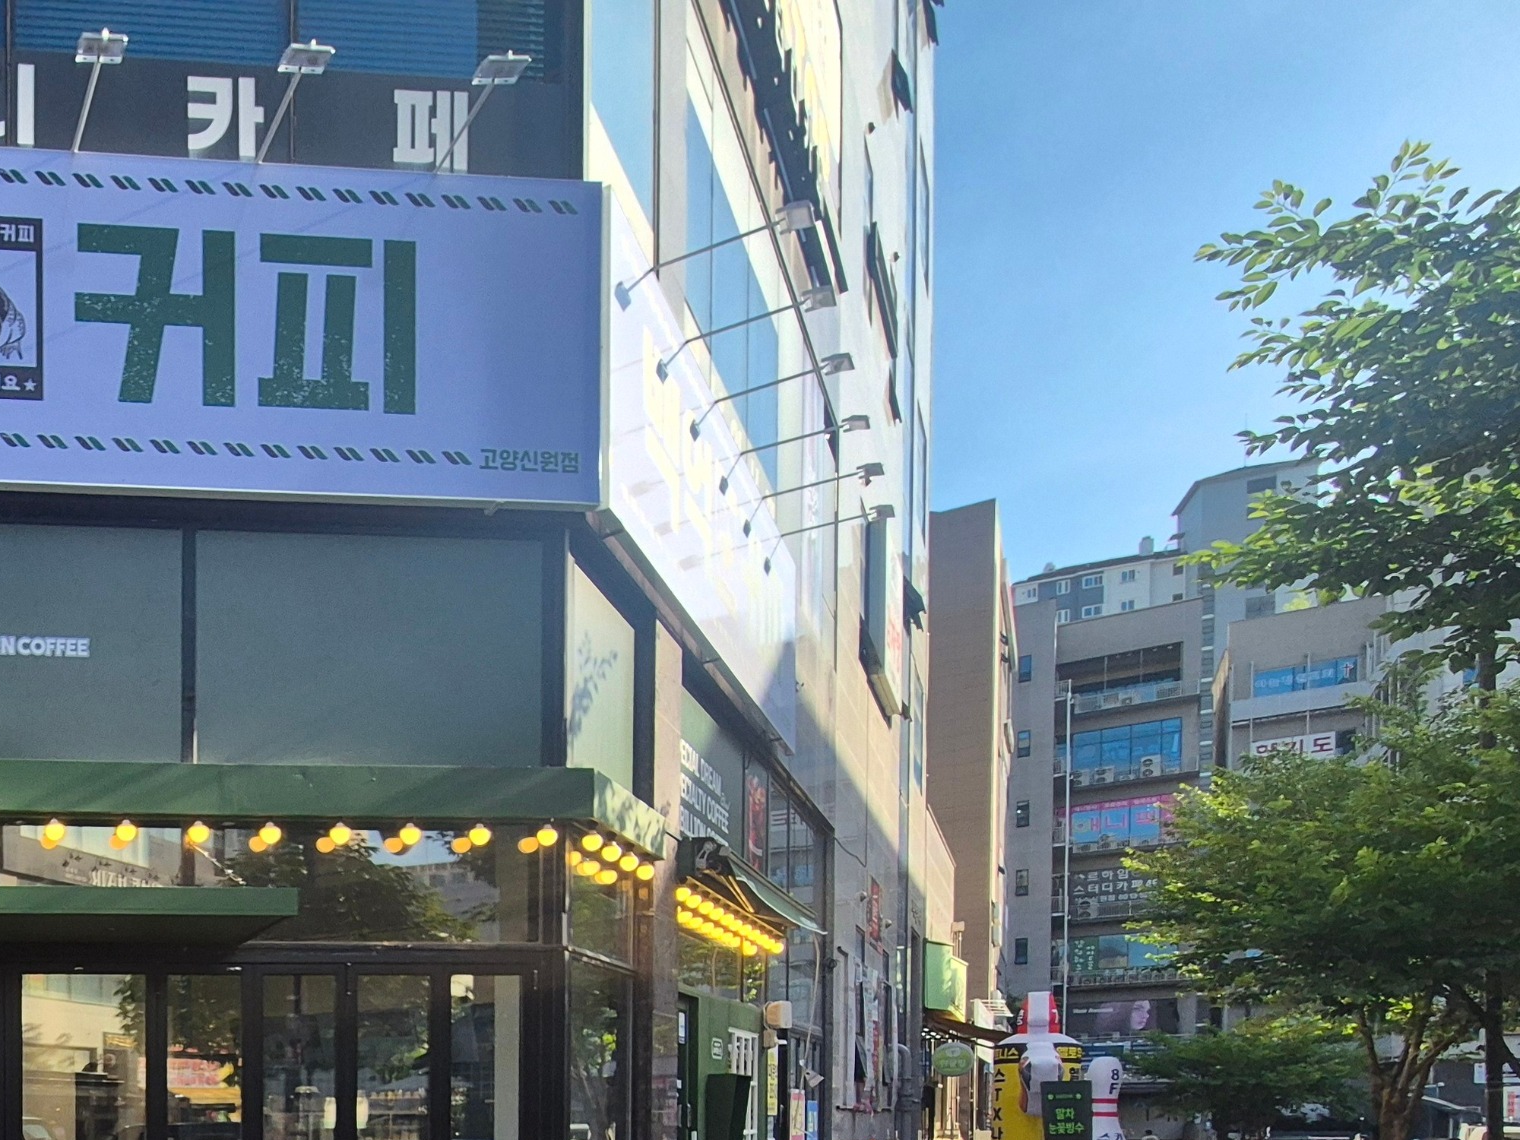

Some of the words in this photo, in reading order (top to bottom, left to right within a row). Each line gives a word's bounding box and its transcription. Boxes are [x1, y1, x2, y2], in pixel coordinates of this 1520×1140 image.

[74, 223, 417, 415] 커피
[480, 448, 580, 474] 고양신원점
[17, 636, 90, 658] COFFEE
